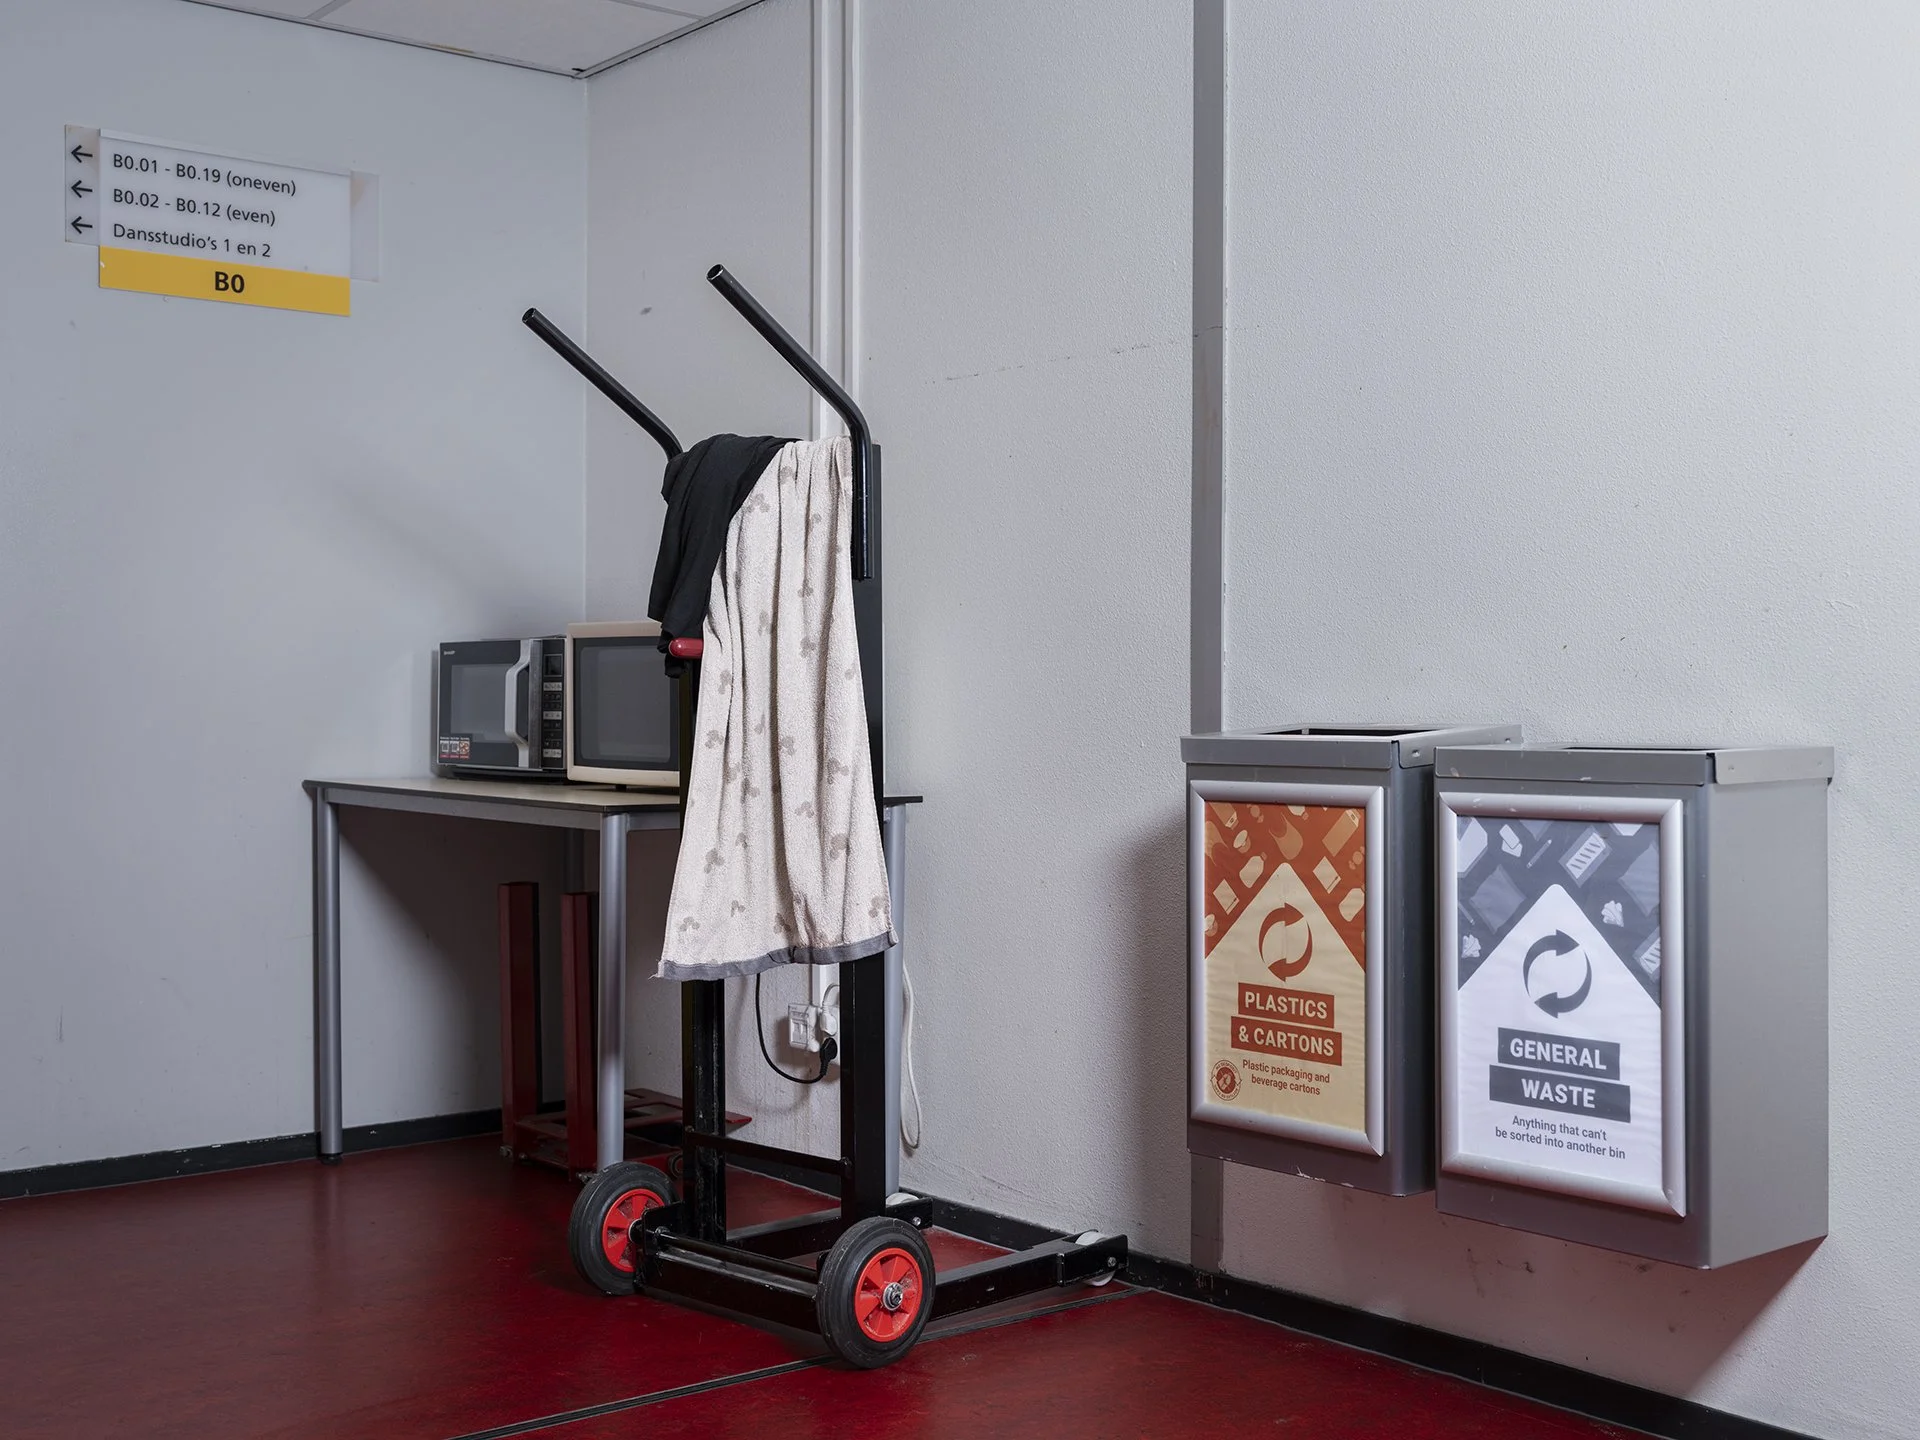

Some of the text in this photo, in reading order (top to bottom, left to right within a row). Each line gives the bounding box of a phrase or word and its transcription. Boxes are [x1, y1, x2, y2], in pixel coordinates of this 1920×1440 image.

[113, 153, 158, 174] B0.01
[176, 163, 221, 183] B0.19
[226, 170, 297, 197] (oneven)
[113, 188, 159, 209] B0.02
[176, 198, 221, 217] B0.12
[226, 205, 276, 227] (even)
[113, 224, 271, 257] Dansstudio's 1 en 2
[214, 271, 245, 294] B0
[1244, 991, 1328, 1020] PLASTICS
[1238, 1025, 1335, 1057] & CARTONS
[1509, 1038, 1607, 1070] GENERAL
[1242, 1059, 1270, 1073] Plastic
[1271, 1065, 1313, 1083] packaging
[1315, 1073, 1330, 1083] and
[1251, 1074, 1321, 1095] beverage cartons
[1521, 1078, 1596, 1109] WASTE
[1495, 1127, 1626, 1159] be sorted into another bin
[1512, 1115, 1607, 1141] Anything that can't
